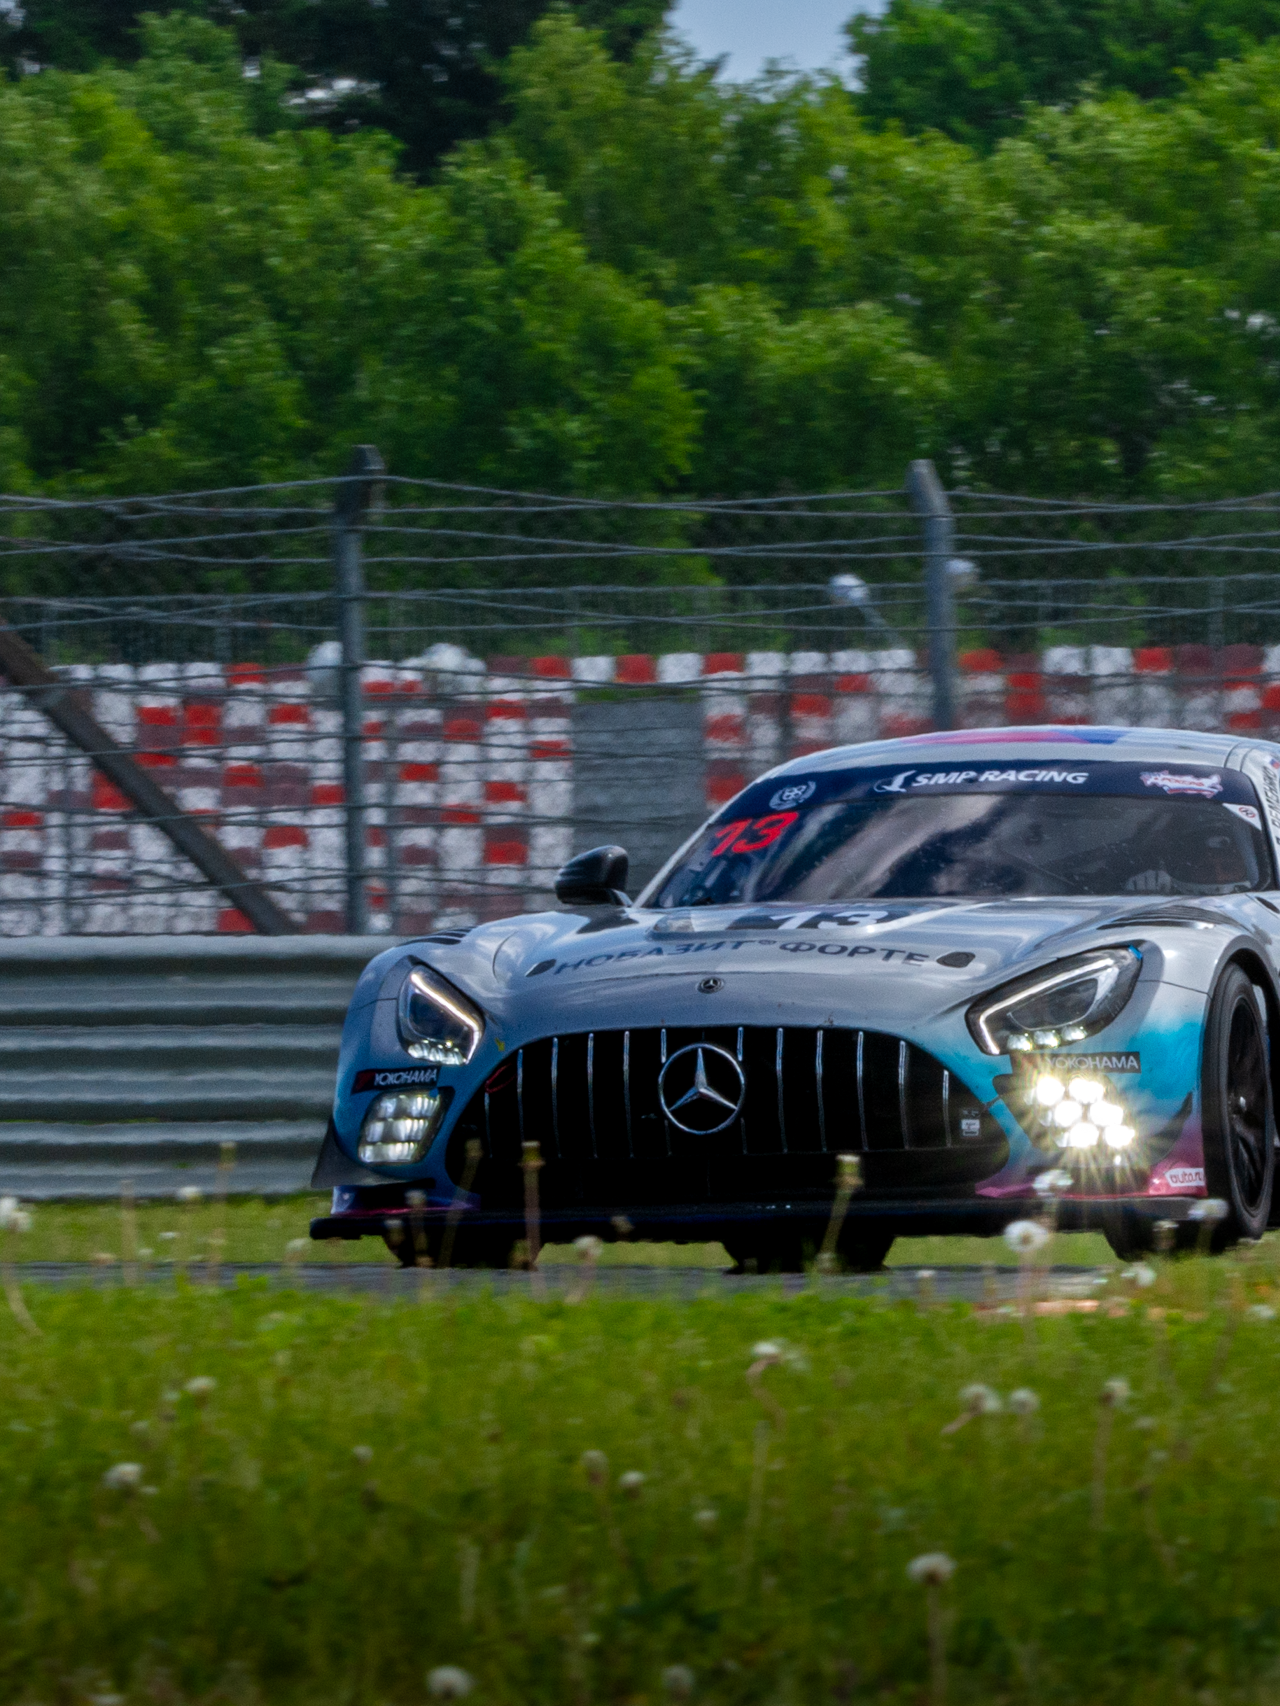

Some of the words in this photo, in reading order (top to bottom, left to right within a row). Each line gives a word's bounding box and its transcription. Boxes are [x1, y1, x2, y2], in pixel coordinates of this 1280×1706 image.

[912, 771, 978, 787] SMP
[979, 770, 1090, 785] RACING
[712, 811, 799, 857] 13
[770, 911, 889, 930] 13
[779, 941, 930, 967] ФОРТЕ
[1046, 1055, 1140, 1069] YOKOHAMA
[374, 1068, 438, 1086] YOKOHAMA
